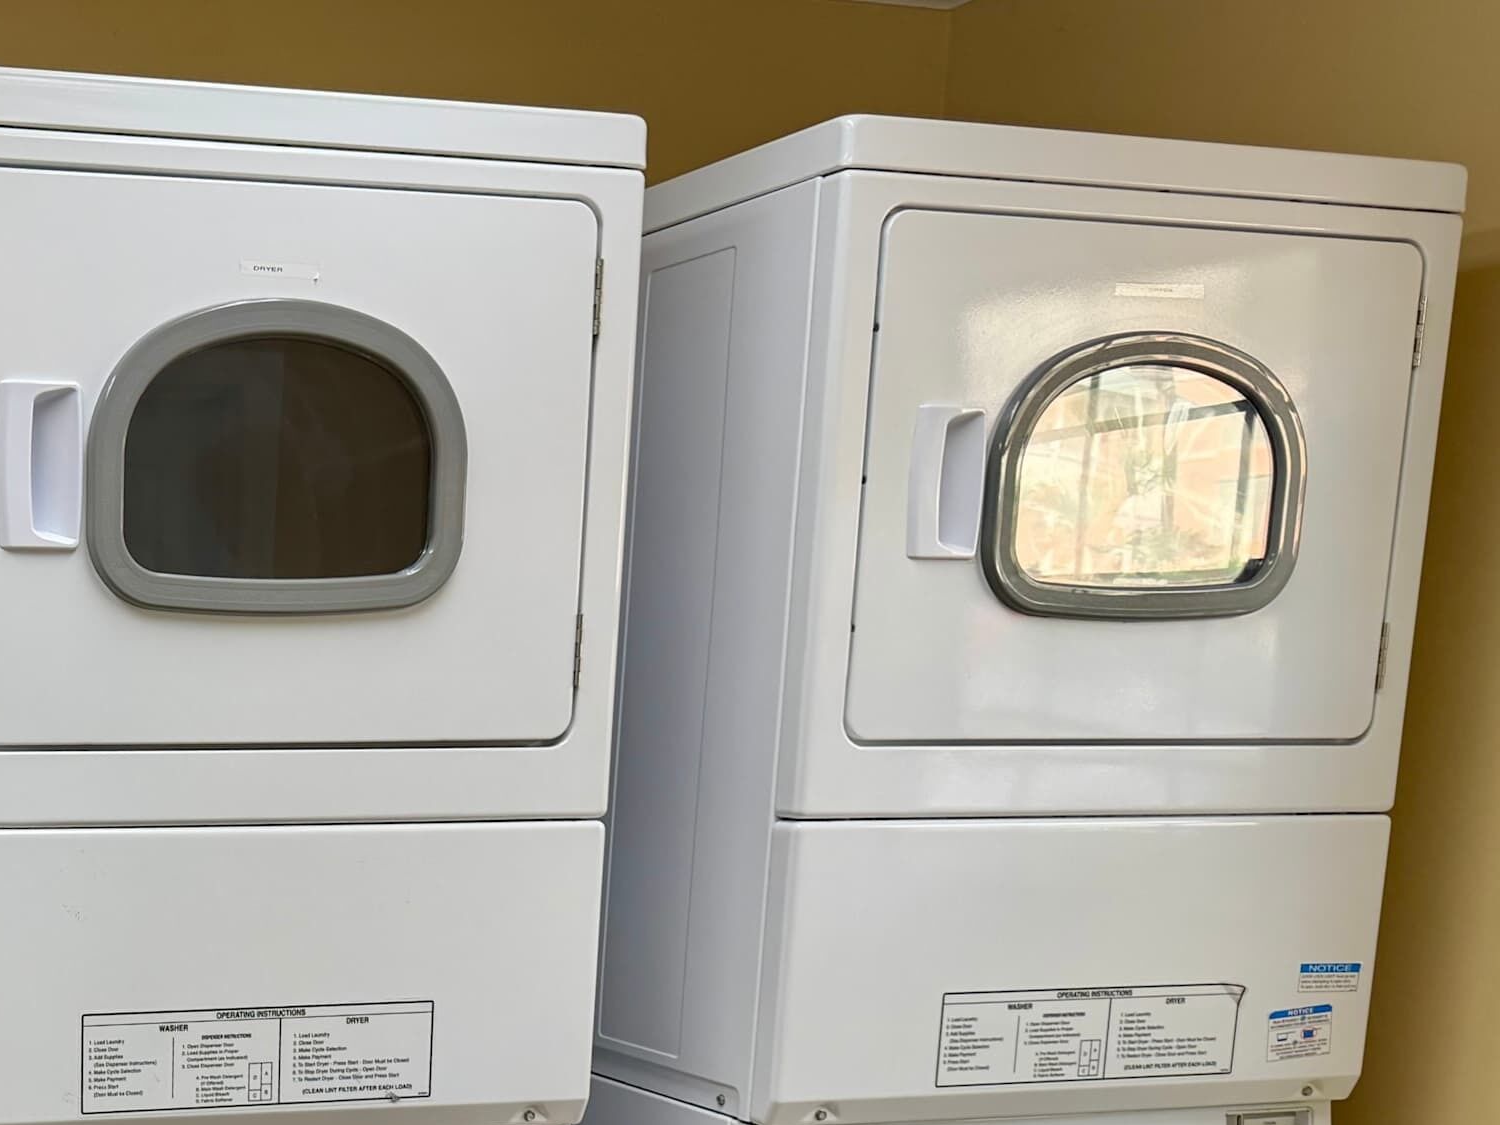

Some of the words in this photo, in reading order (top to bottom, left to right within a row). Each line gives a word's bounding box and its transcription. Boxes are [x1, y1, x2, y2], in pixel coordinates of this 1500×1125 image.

[216, 1011, 255, 1019] OPERATING
[257, 1009, 306, 1018] INSTRUCTIONS
[159, 1024, 188, 1032] WASHER
